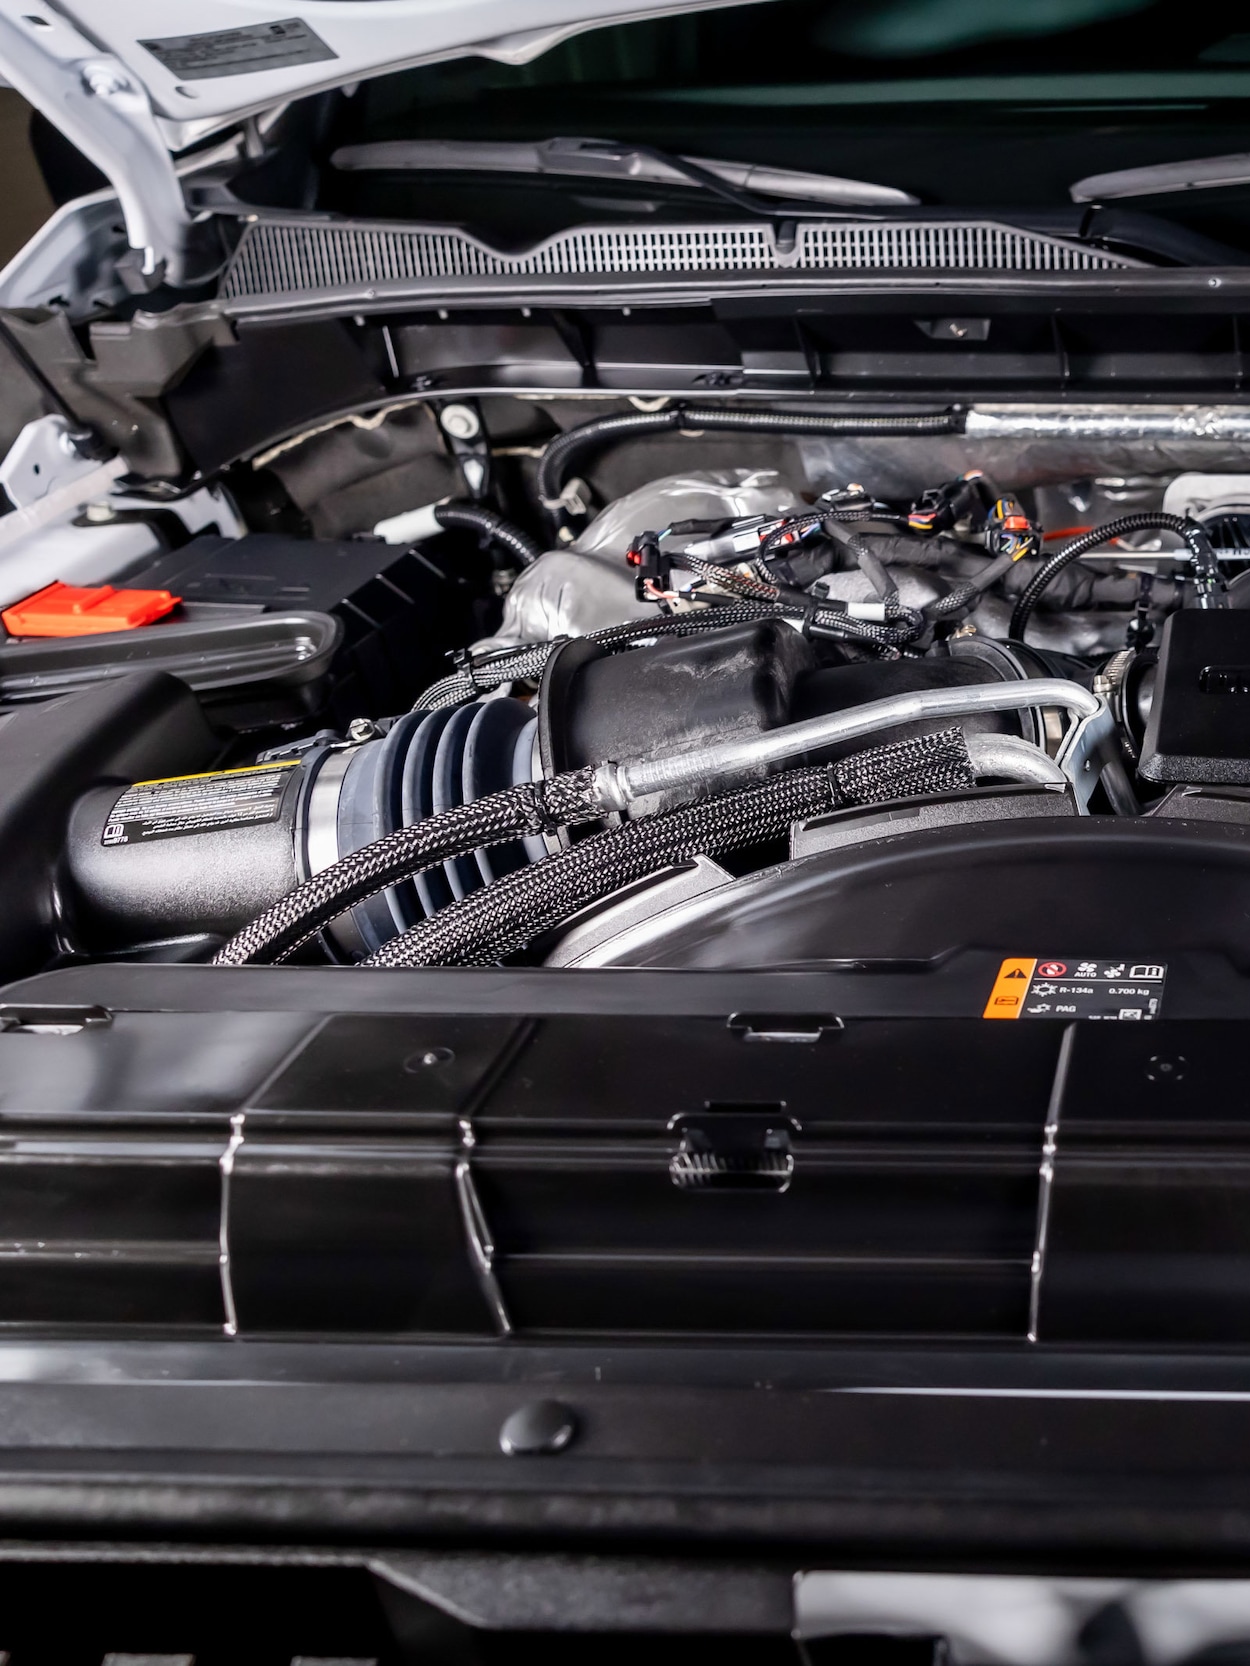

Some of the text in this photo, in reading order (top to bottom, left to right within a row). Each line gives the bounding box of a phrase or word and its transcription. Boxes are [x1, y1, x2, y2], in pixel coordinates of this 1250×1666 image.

[1059, 986, 1150, 996] R-134a 0.700 kg
[1055, 1005, 1077, 1013] PAG
